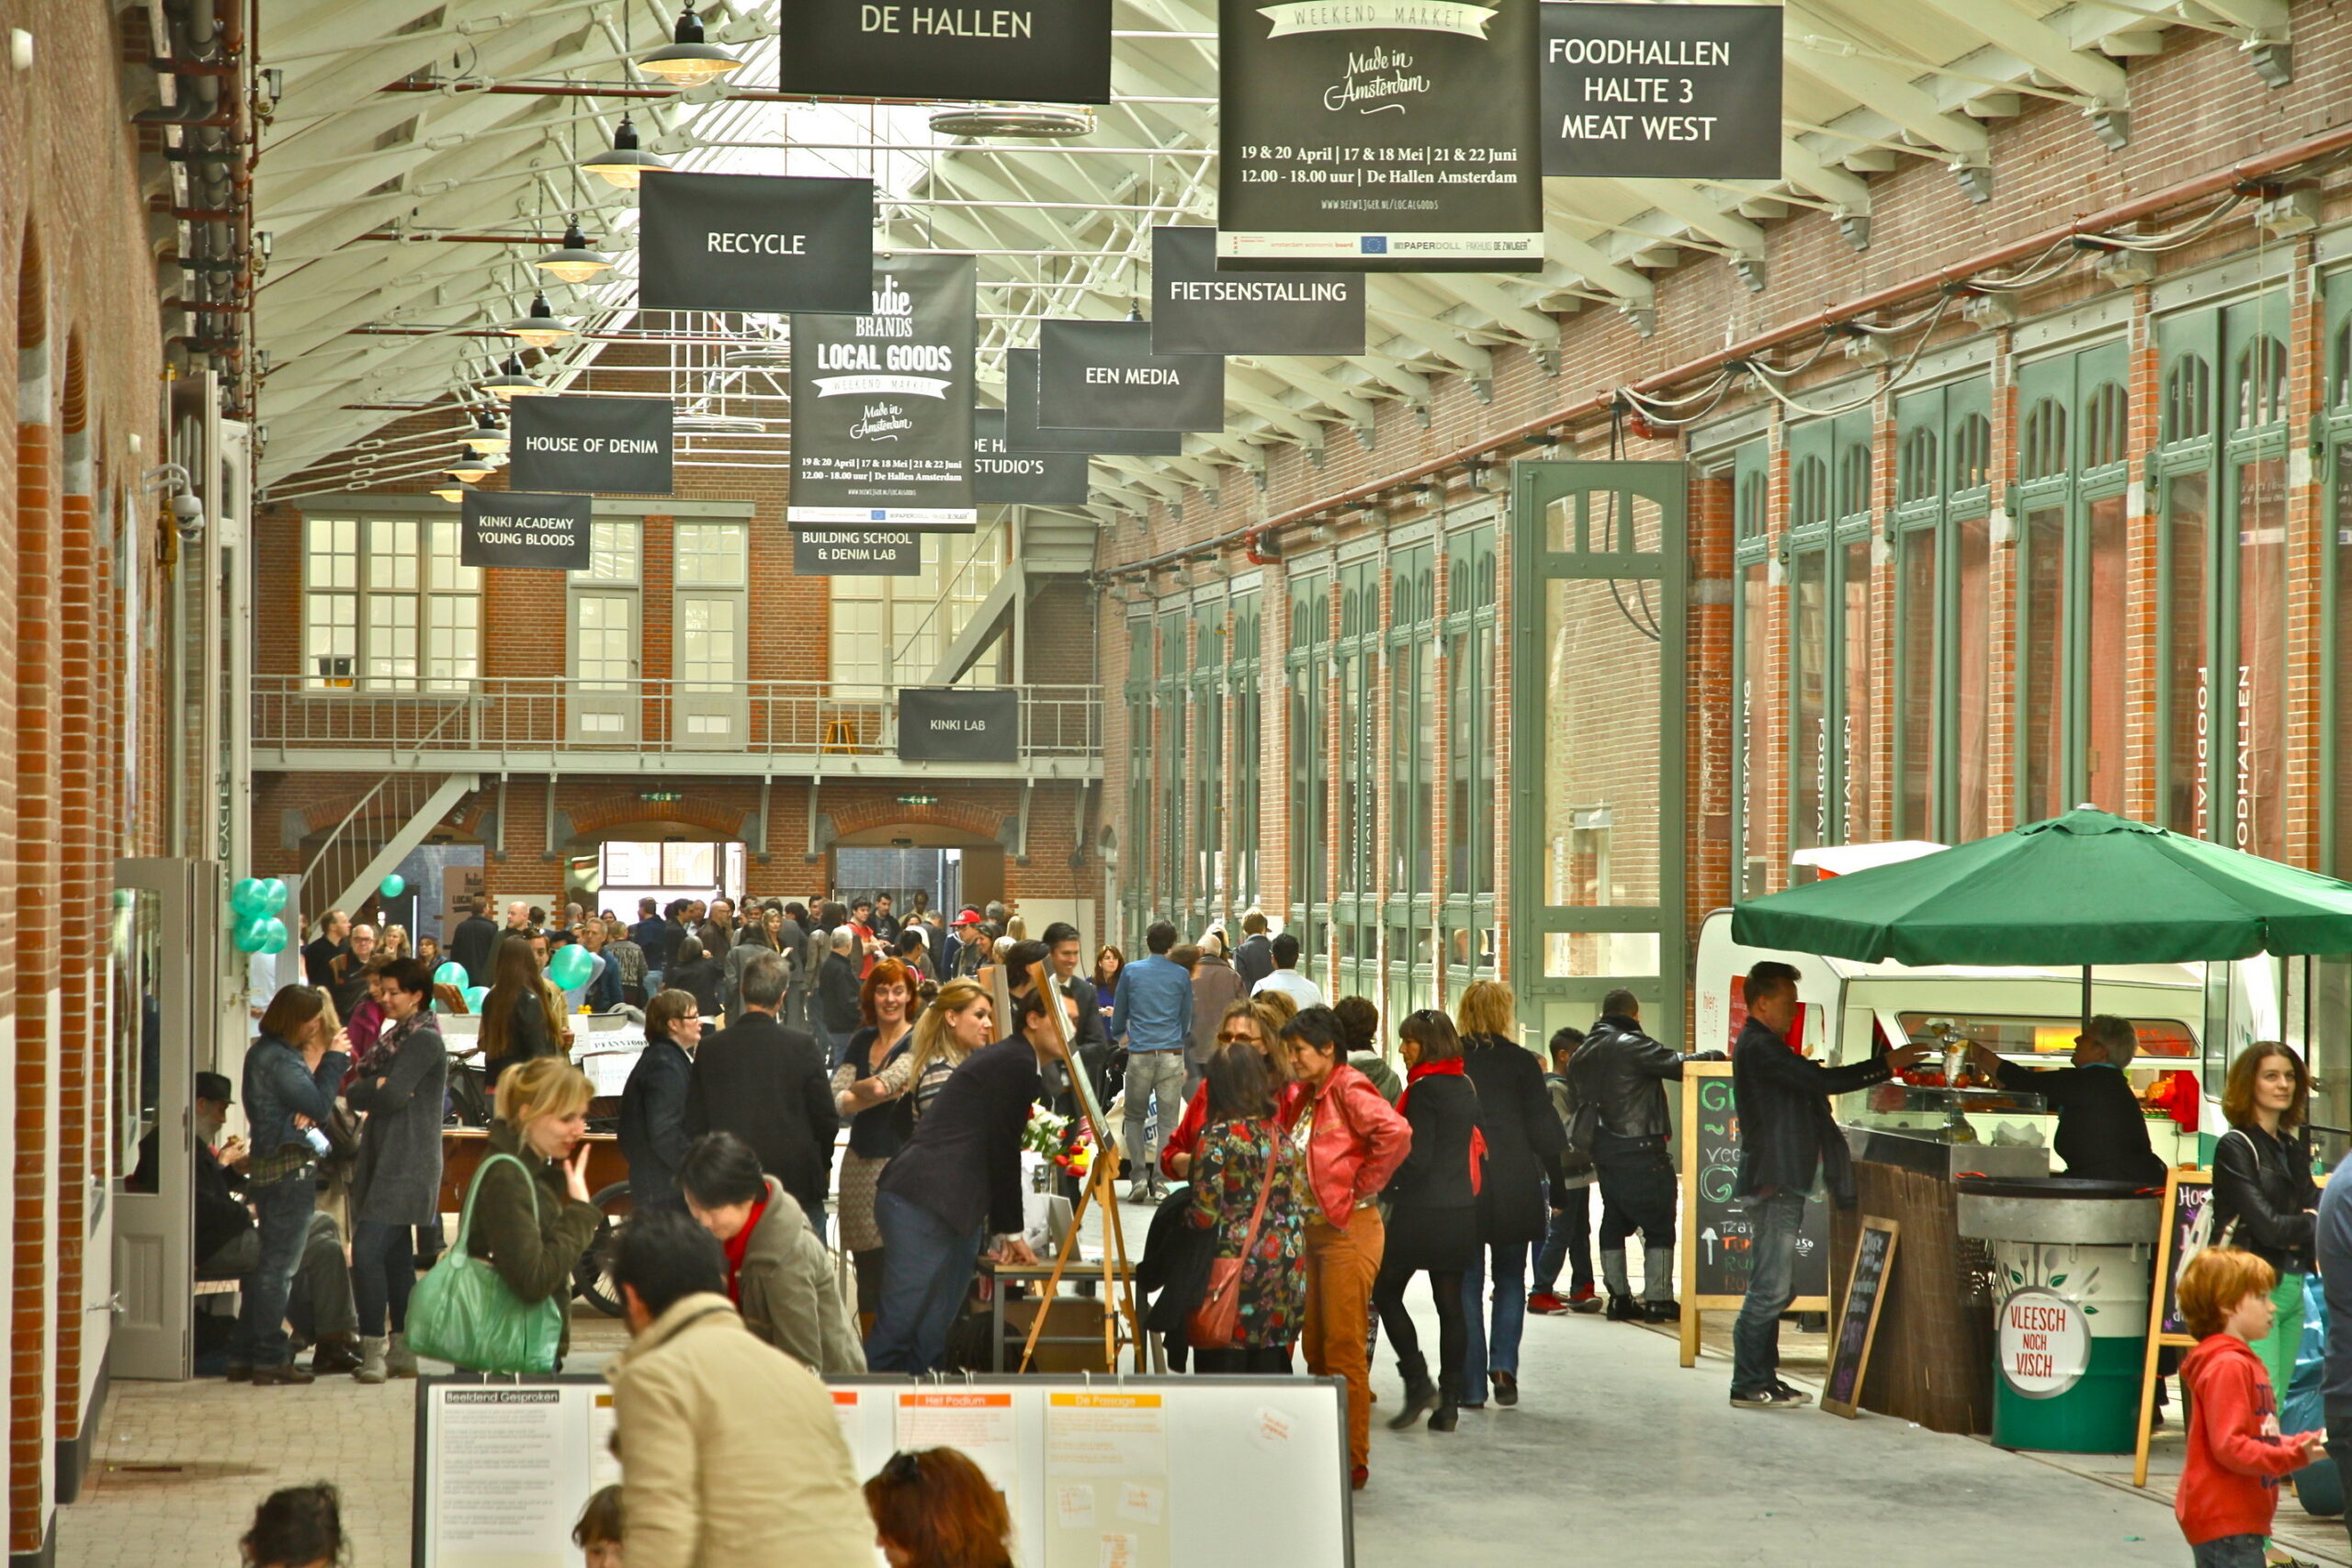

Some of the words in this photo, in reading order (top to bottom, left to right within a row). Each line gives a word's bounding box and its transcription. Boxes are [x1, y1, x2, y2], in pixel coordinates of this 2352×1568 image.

[861, 5, 900, 34] DE
[912, 6, 1032, 39] HALLEN
[1294, 6, 1376, 26] WEEKEND
[1394, 6, 1464, 28] MARKET
[1342, 45, 1391, 80] Made
[1391, 49, 1414, 70] in
[1549, 39, 1730, 66] FOODHALLEN
[1323, 69, 1431, 111] Amsterdam
[1584, 76, 1669, 103] HALTE
[1679, 78, 1693, 104] 3
[1561, 114, 1634, 140] MEAT
[1641, 116, 1718, 141] WEST
[1241, 145, 1258, 159] 19
[1274, 145, 1293, 159] 20
[1296, 146, 1332, 164] April
[1344, 147, 1360, 161] 17
[1379, 148, 1395, 162] 18
[1397, 147, 1424, 162] Mei
[1433, 148, 1450, 162] 21
[1468, 148, 1486, 162] 22
[1487, 148, 1518, 164] Juni
[1241, 169, 1279, 183] 12.00
[1290, 169, 1328, 183] 18.00
[1329, 173, 1355, 183] uur
[1366, 169, 1387, 184] De
[1388, 169, 1435, 184] Hallen
[1437, 169, 1518, 184] Amsterdam
[707, 231, 806, 255] RECYCLE
[1170, 281, 1347, 302] FIETSENSTALLING
[855, 316, 912, 337] BRANDS
[818, 343, 882, 371] LOCAL
[886, 344, 953, 372] GOODS
[1086, 367, 1120, 384] EEN
[1125, 367, 1181, 386] MEDIA
[526, 436, 579, 452] HOUSE
[582, 437, 605, 453] OF
[609, 438, 659, 454] DENIM
[975, 459, 1044, 474] STUDIO'S
[479, 515, 512, 528] KINKI
[514, 516, 574, 530] ACADEMY
[477, 532, 523, 545] YOUNG
[526, 533, 575, 547] BLOODS
[802, 532, 860, 544] BUILDING
[863, 532, 913, 545] SCHOOL
[818, 547, 828, 560] &
[831, 547, 870, 560] DENIM
[873, 548, 897, 560] LAB
[930, 719, 961, 730] KINKI
[964, 719, 986, 731] LAB
[2197, 667, 2208, 843] FOODHALL
[2238, 664, 2251, 854] ODHALLEN
[1742, 679, 1751, 893] FIETSENSTALLING
[1816, 717, 1826, 846] FOODHAL
[2010, 1304, 2066, 1332] VLEESCH
[2023, 1333, 2047, 1351] NOCH
[2016, 1352, 2052, 1378] VISCH
[447, 1392, 497, 1403] Beeldend
[500, 1391, 559, 1405] Gesproken
